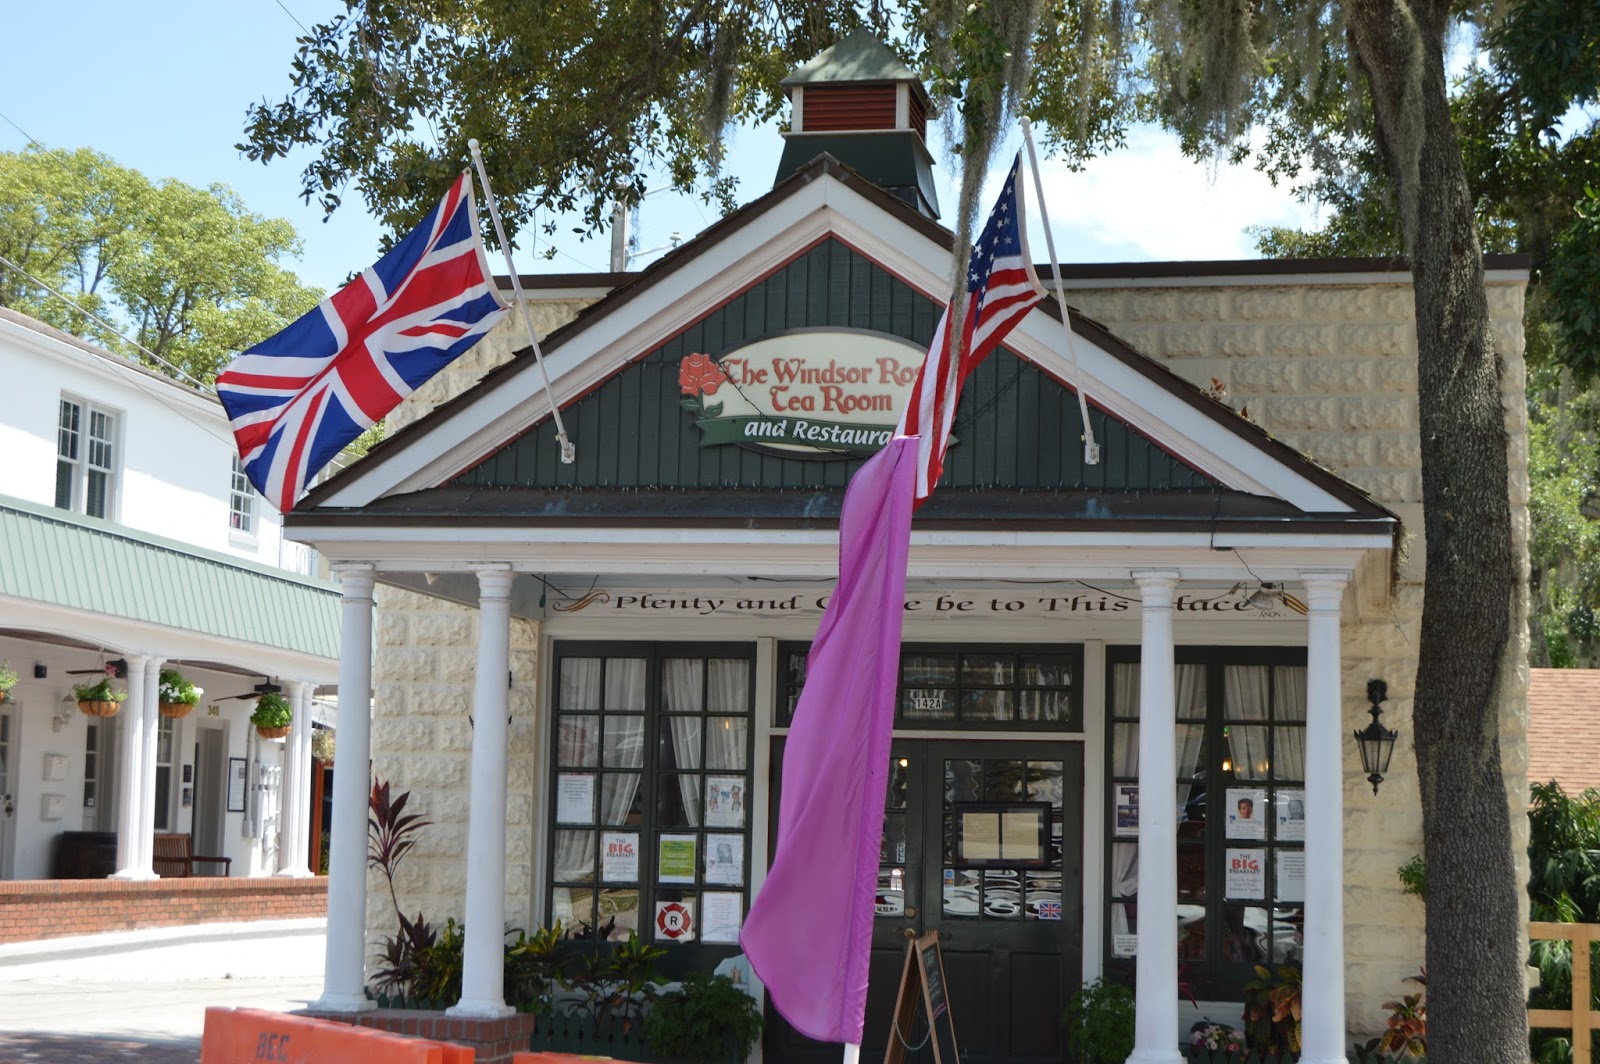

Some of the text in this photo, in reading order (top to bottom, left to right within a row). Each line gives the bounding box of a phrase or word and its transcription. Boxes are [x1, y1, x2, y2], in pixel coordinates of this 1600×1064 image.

[724, 357, 921, 387] The Windsor Ro
[770, 385, 893, 414] Tea Room
[744, 420, 893, 446] and Restaura
[613, 594, 724, 614] Plenty
[736, 594, 801, 610] and
[936, 594, 974, 612] be
[991, 597, 1024, 612] to
[1038, 595, 1129, 612] This
[1175, 594, 1255, 612] lace
[609, 843, 634, 854] BIG
[1232, 859, 1259, 870] BIG
[670, 916, 678, 925] R
